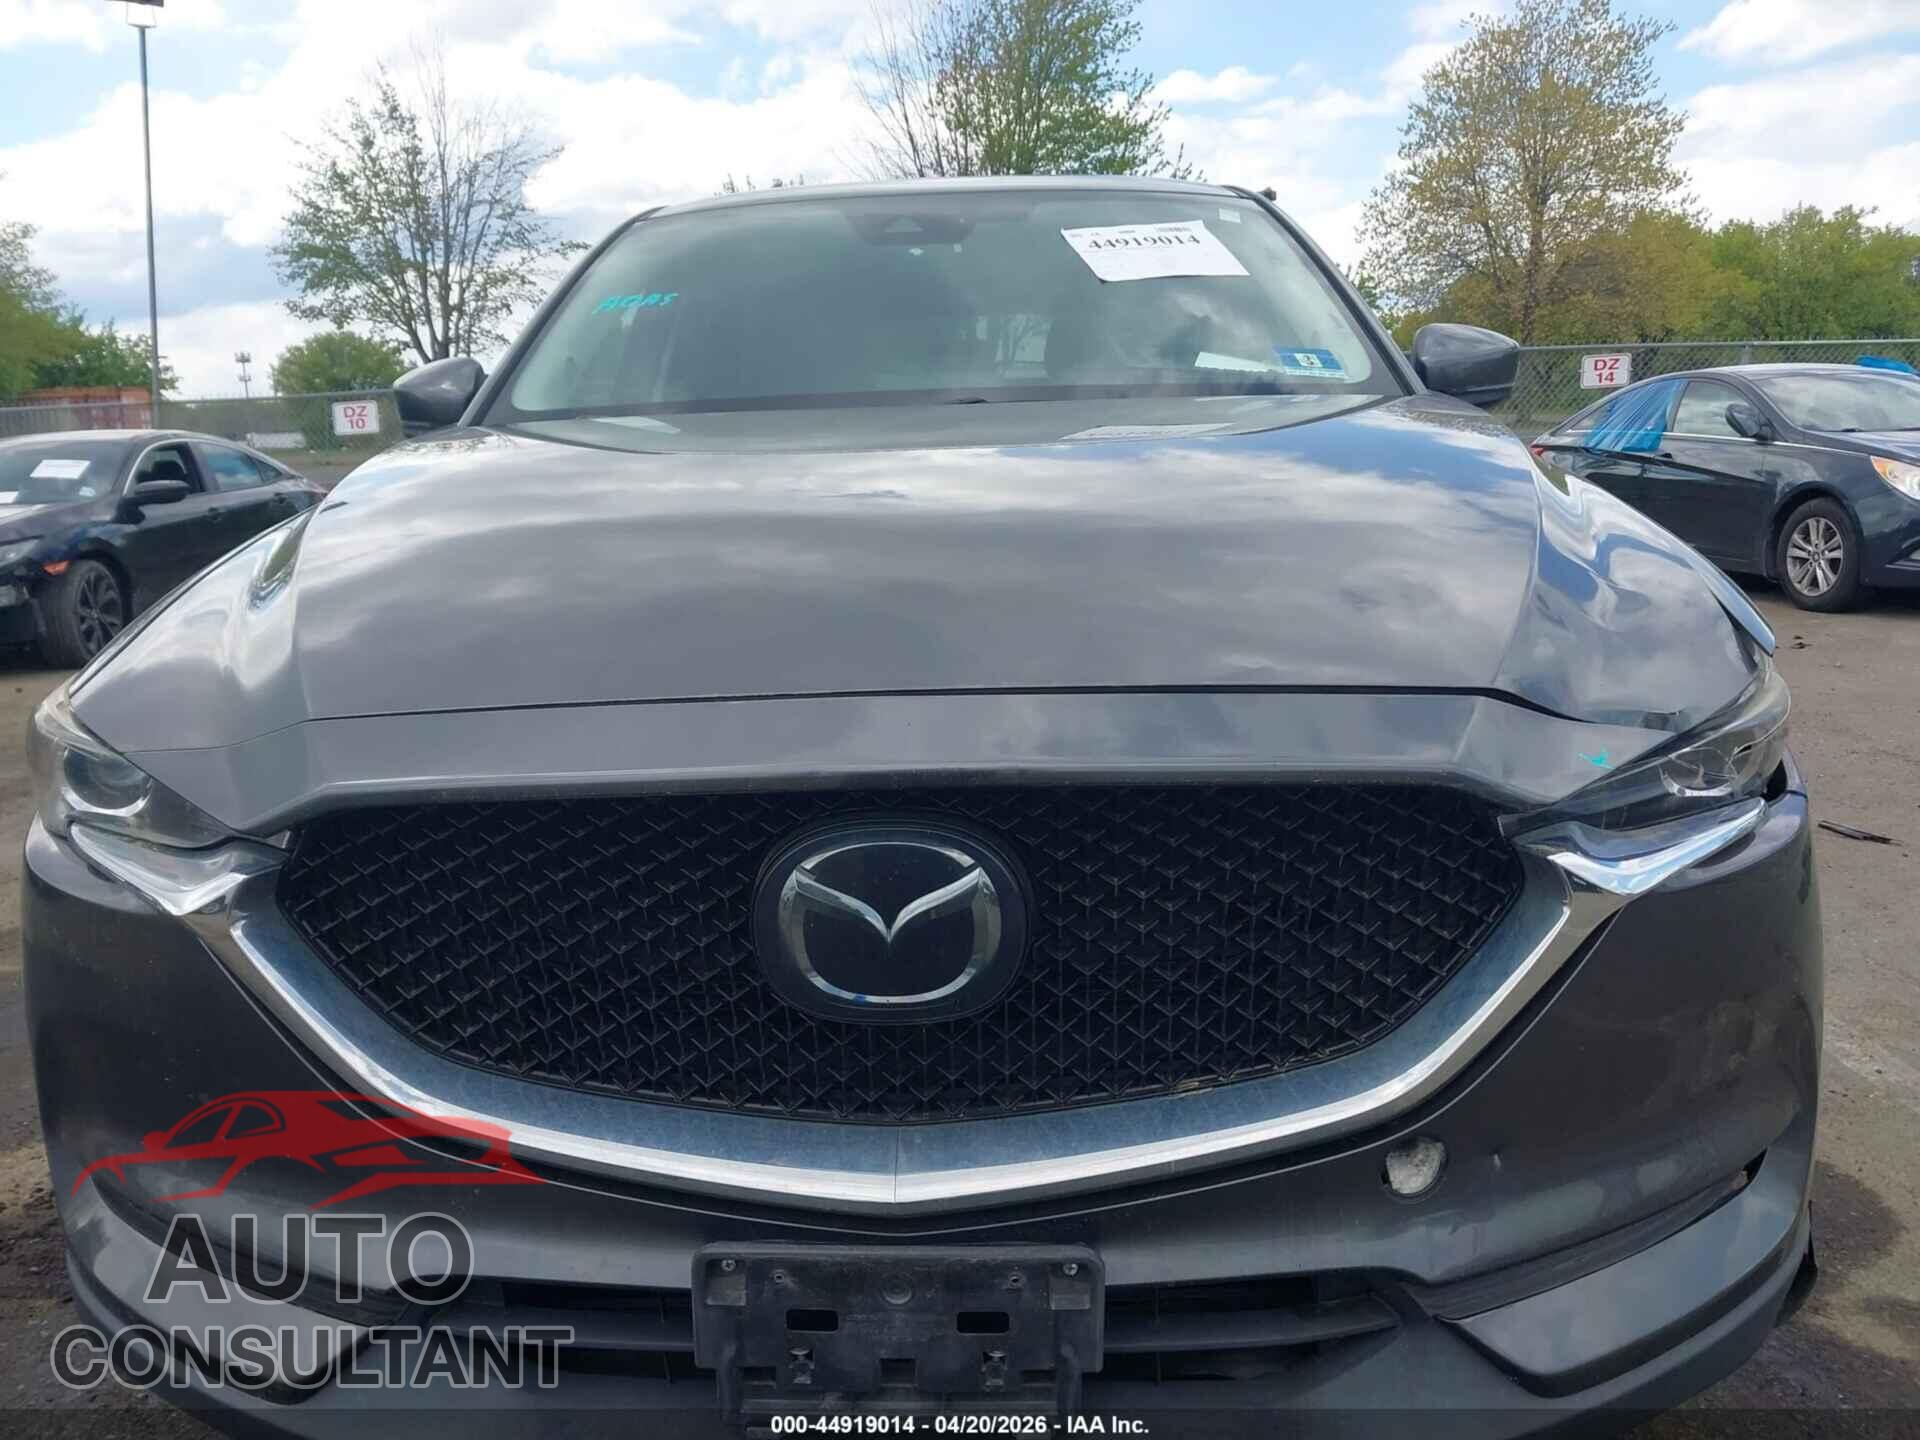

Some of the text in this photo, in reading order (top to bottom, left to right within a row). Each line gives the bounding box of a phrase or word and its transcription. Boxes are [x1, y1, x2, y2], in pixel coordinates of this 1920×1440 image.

[1089, 235, 1200, 249] 44919014
[1594, 358, 1621, 371] DZ
[1595, 371, 1615, 384] 14
[343, 405, 368, 418] DZ
[346, 418, 366, 429] 10
